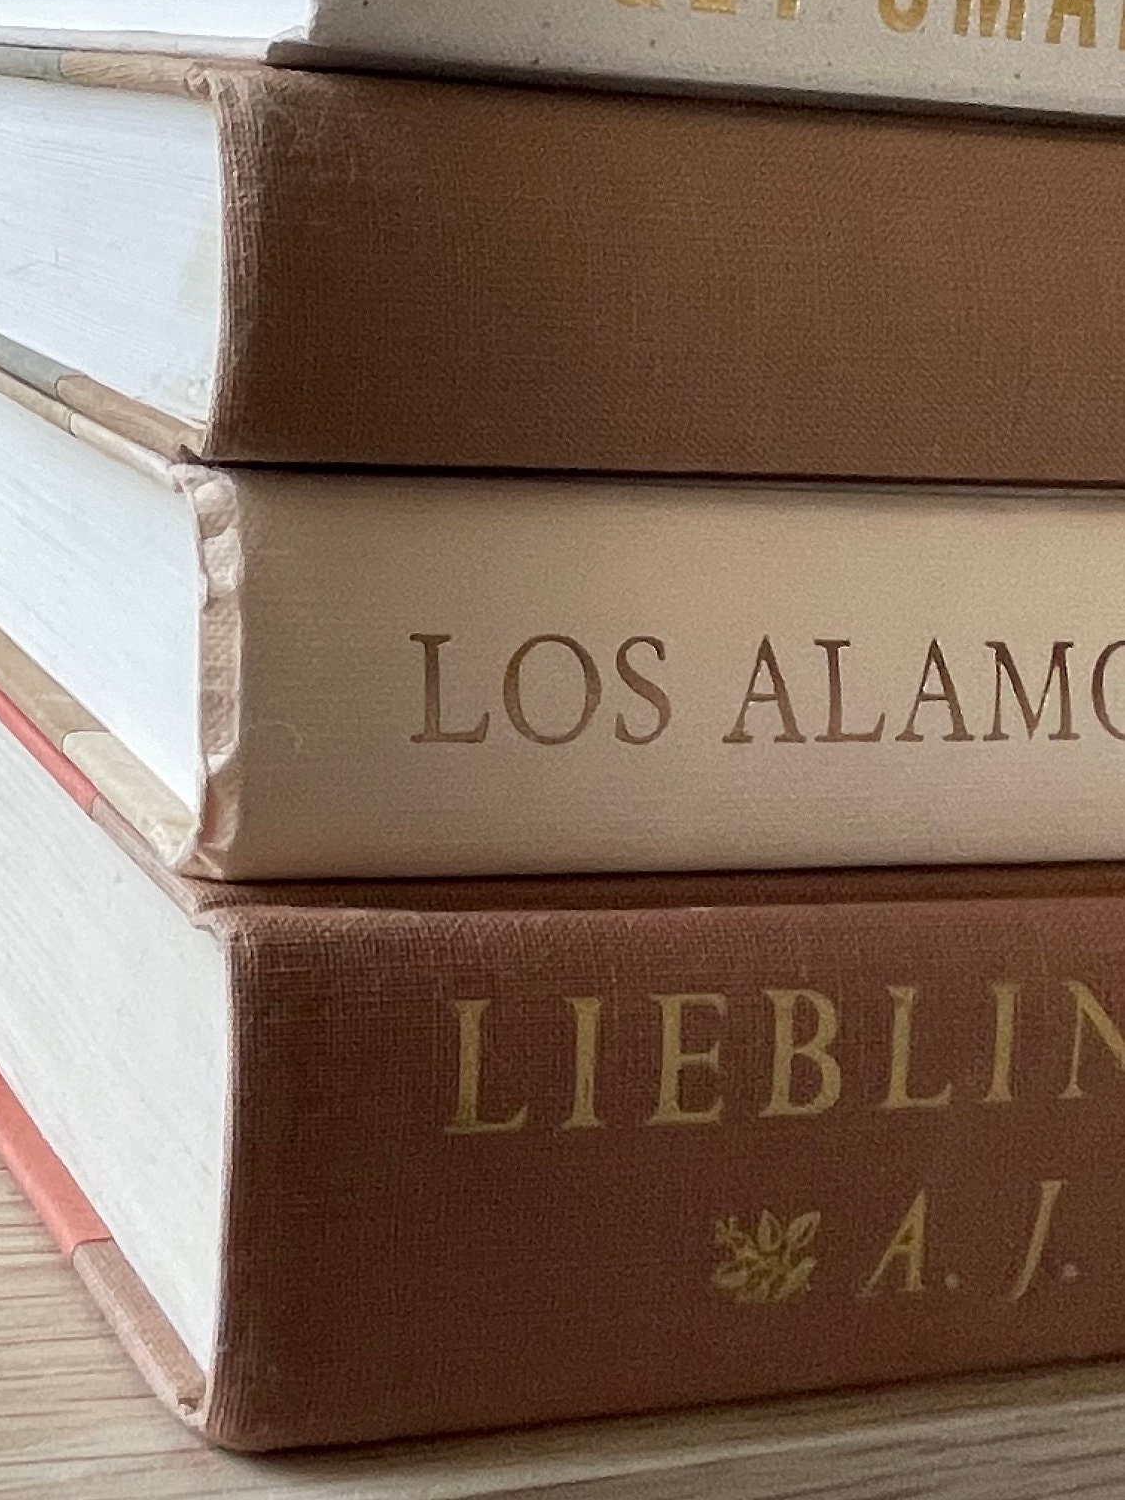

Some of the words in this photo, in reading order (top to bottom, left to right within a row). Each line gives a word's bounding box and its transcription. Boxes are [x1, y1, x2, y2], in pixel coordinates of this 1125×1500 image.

[409, 633, 672, 746] LOS
[855, 1187, 962, 1300] A.
[998, 1178, 1080, 1302] J.
